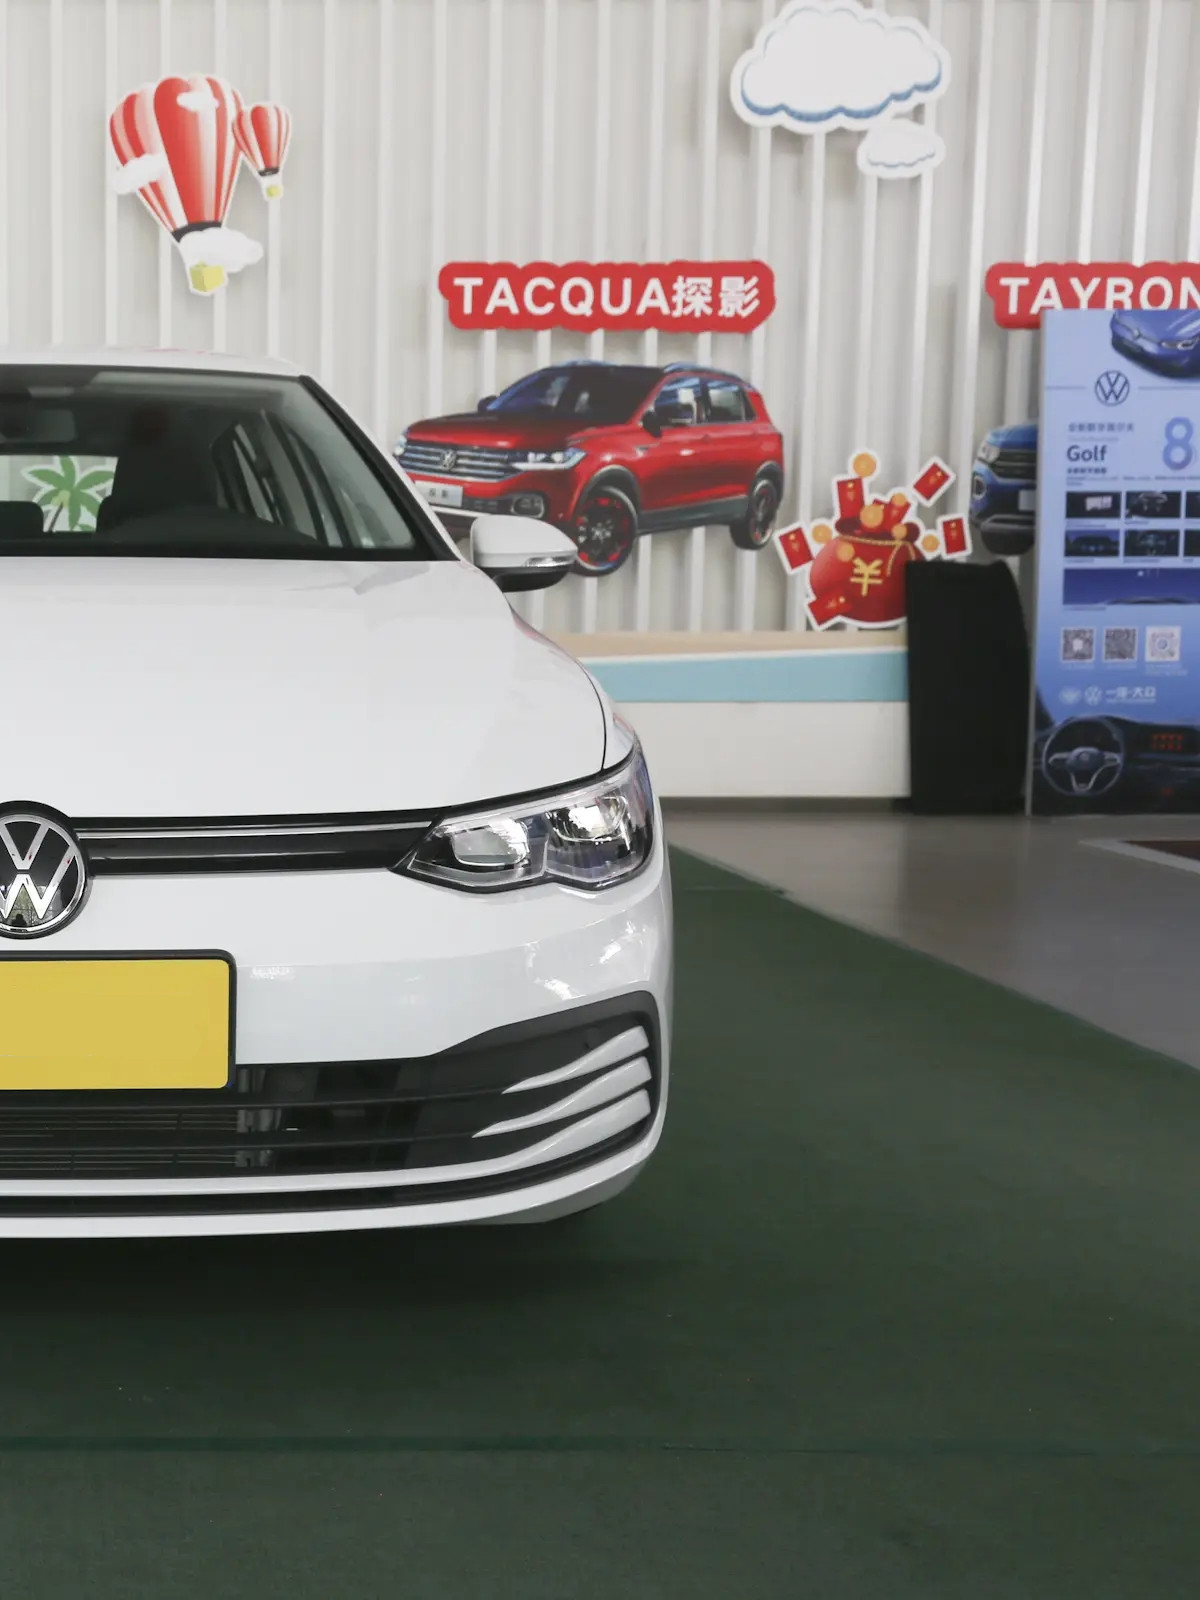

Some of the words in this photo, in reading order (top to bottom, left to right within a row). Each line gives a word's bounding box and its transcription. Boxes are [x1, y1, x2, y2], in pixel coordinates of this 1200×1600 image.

[452, 275, 761, 319] TACQUA探影
[1066, 444, 1108, 462] Golf
[1162, 417, 1194, 471] 8
